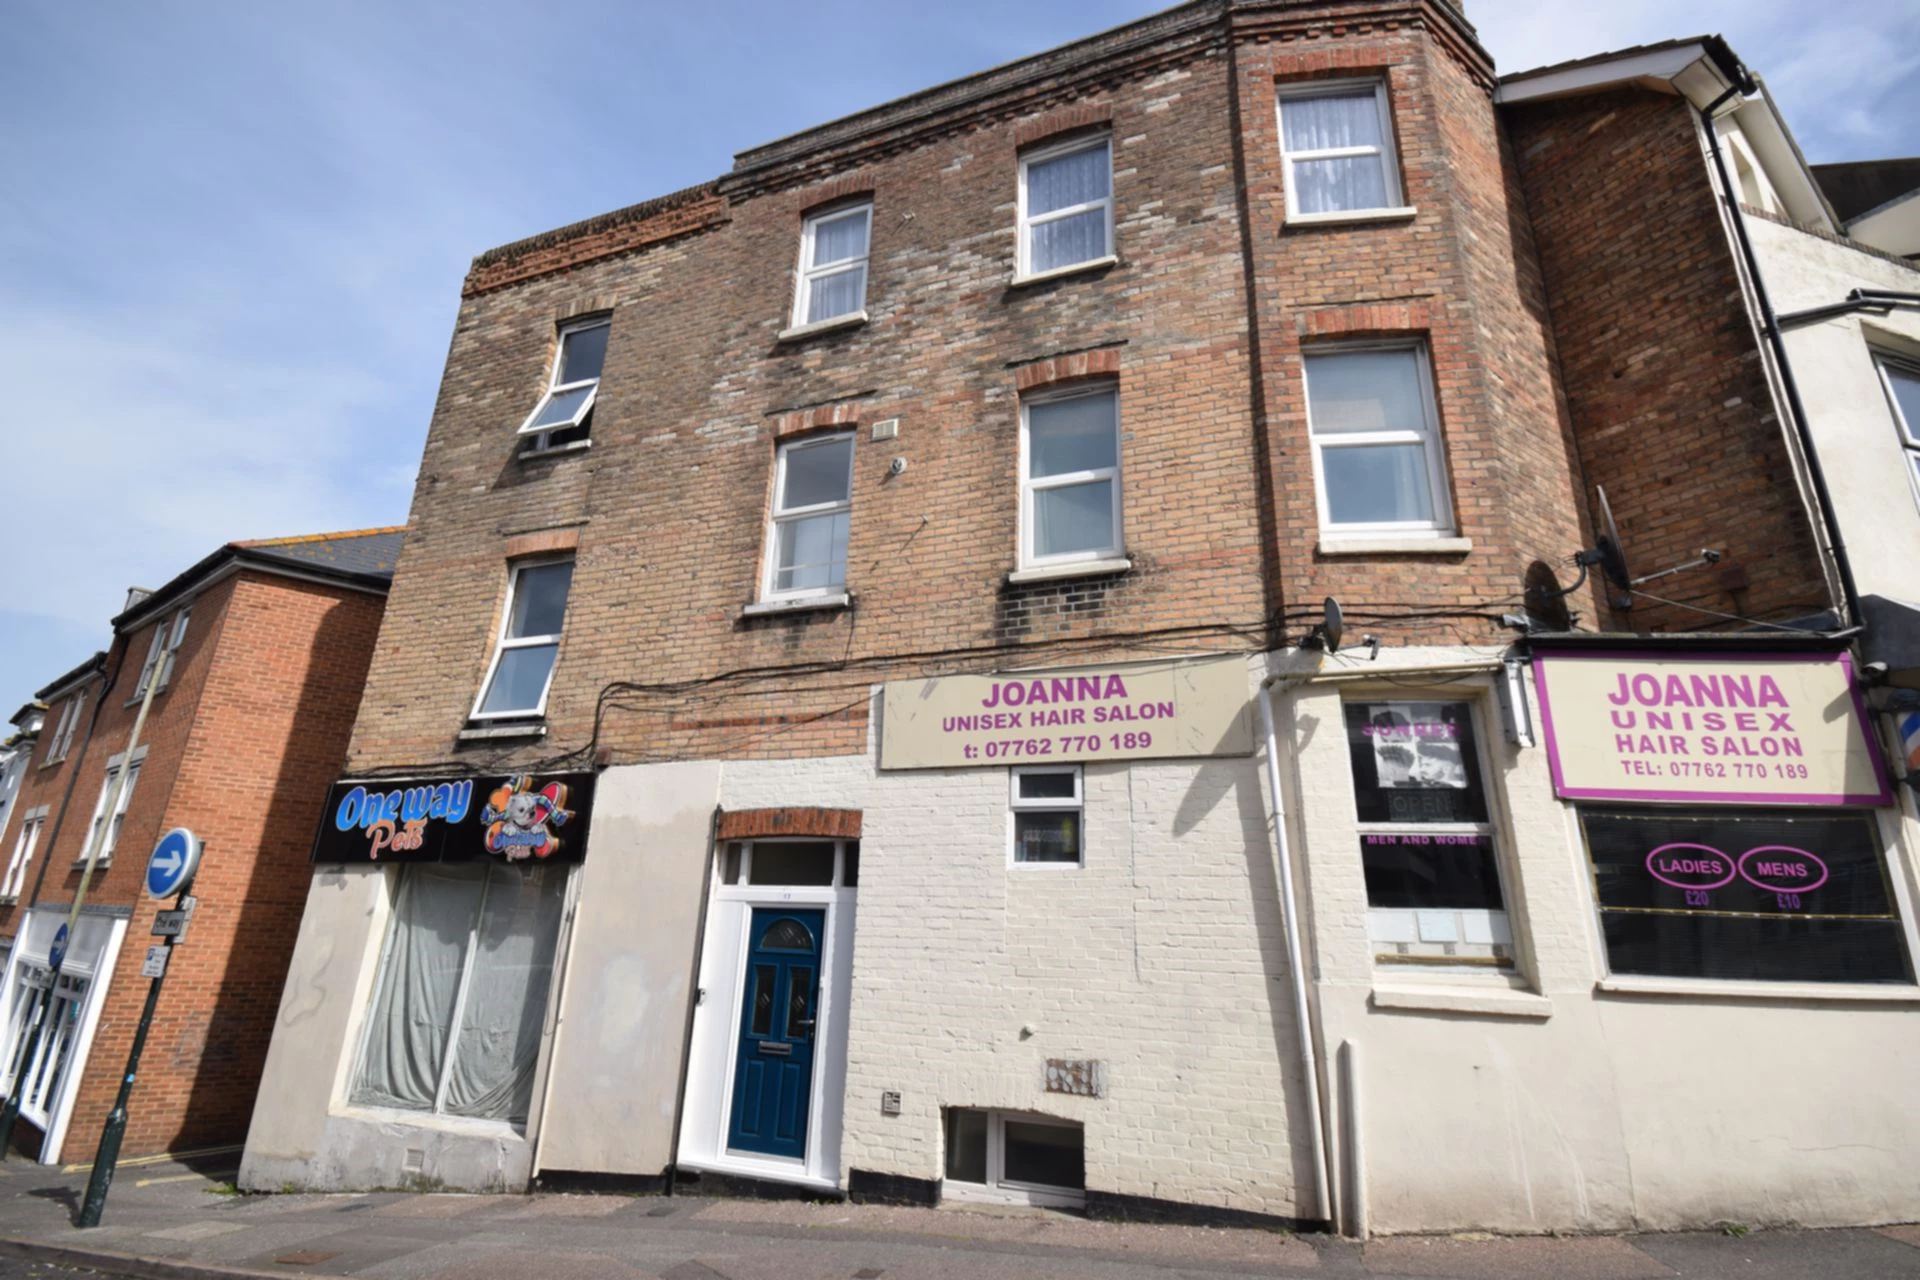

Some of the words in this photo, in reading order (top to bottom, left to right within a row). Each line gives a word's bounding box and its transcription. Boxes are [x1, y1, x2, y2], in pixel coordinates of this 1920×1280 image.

[981, 674, 1128, 708] JOANNA
[1608, 673, 1789, 707] JOANNA
[943, 713, 1023, 732] UNISEX
[1030, 708, 1086, 727] HAIR
[1093, 702, 1175, 723] SALON
[1611, 710, 1795, 732] UNISEX
[963, 743, 979, 758] t:
[985, 738, 1052, 758] 07762
[1060, 735, 1101, 753] 770
[1110, 731, 1152, 750] 189
[1616, 734, 1690, 755] HAIR
[1702, 735, 1804, 757] SALON
[1622, 759, 1663, 776] TEL:
[1670, 761, 1727, 778] 07762
[1733, 763, 1768, 778] 770
[1775, 764, 1809, 779] 189
[366, 818, 427, 859] Pets
[1366, 835, 1397, 845] MEN
[1402, 835, 1431, 845] AND
[1658, 858, 1723, 875] LADIES
[1756, 862, 1808, 878] MENS
[1685, 891, 1710, 906] £20
[1776, 894, 1802, 910] £10
